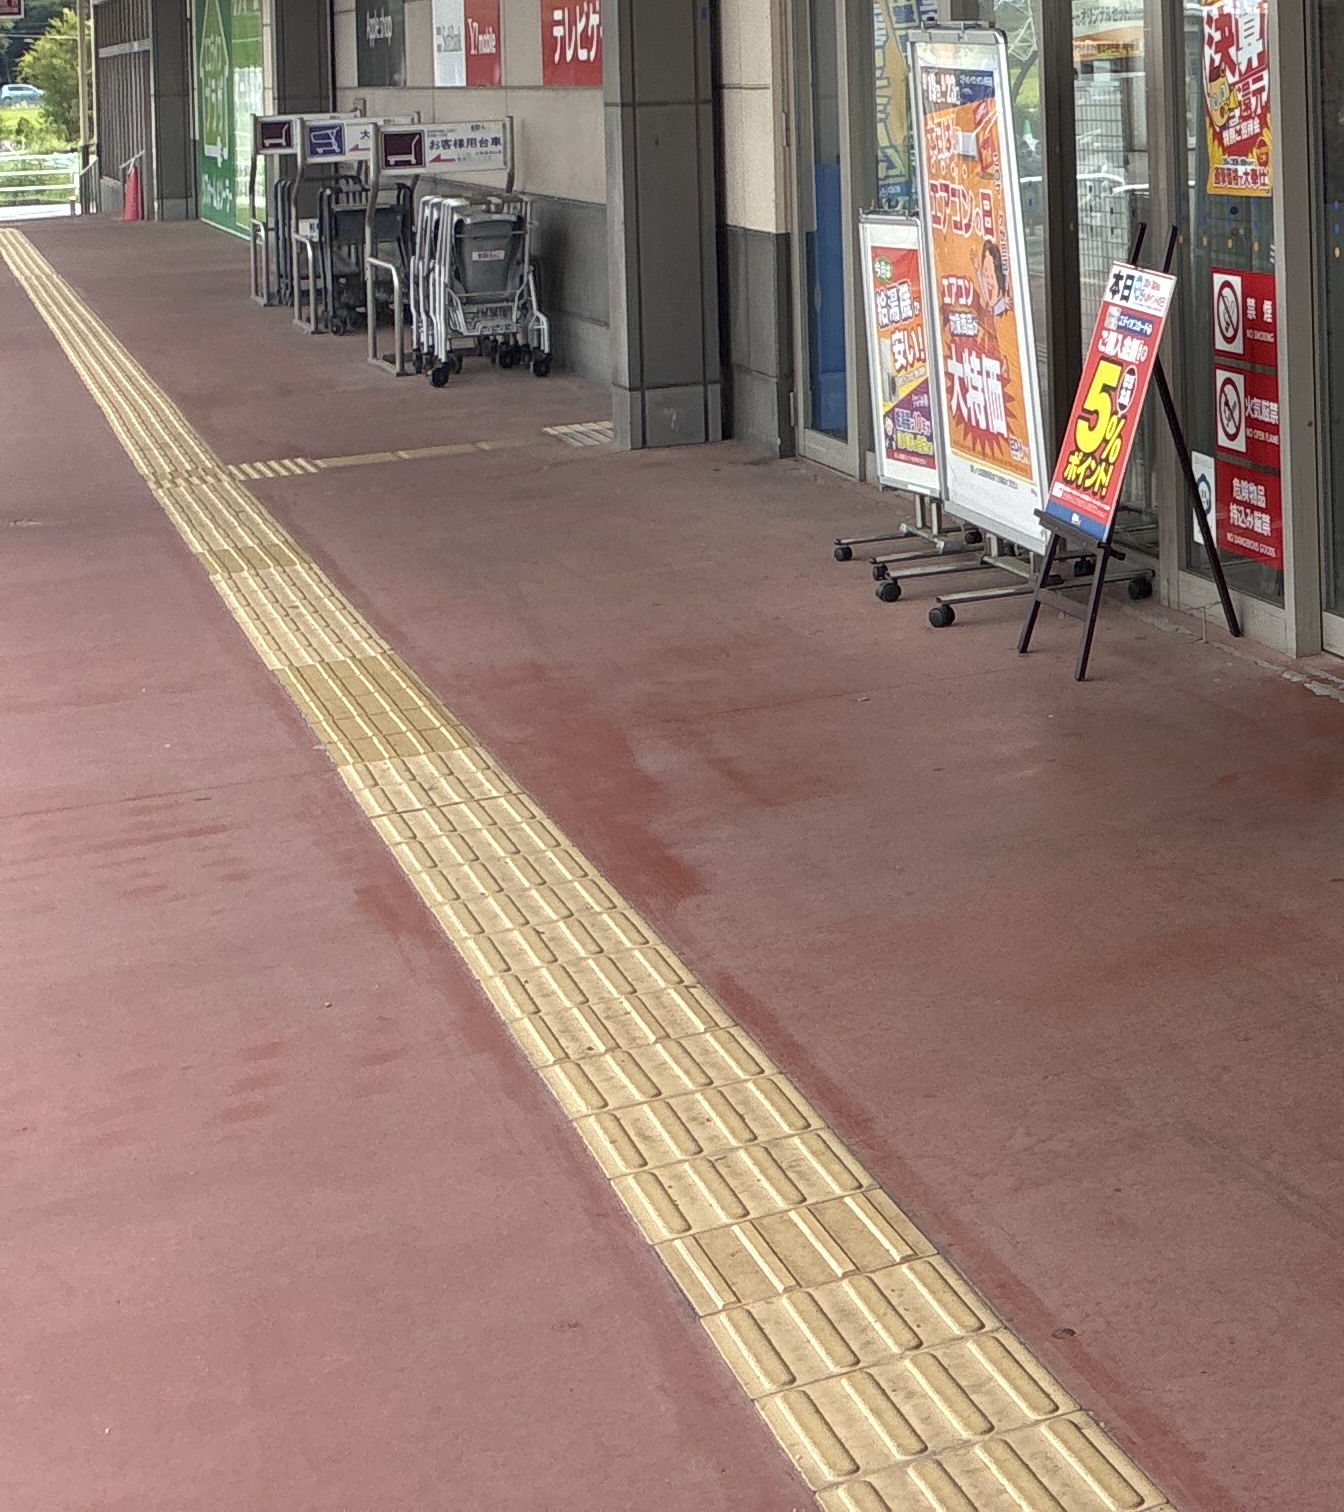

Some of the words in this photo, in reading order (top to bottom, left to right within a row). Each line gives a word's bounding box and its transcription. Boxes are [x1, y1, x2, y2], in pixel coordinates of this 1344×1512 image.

[428, 138, 502, 151] お客様用台車
[941, 276, 974, 309] エアコン
[1108, 270, 1135, 304] 本日
[946, 343, 1008, 438] 大特価
